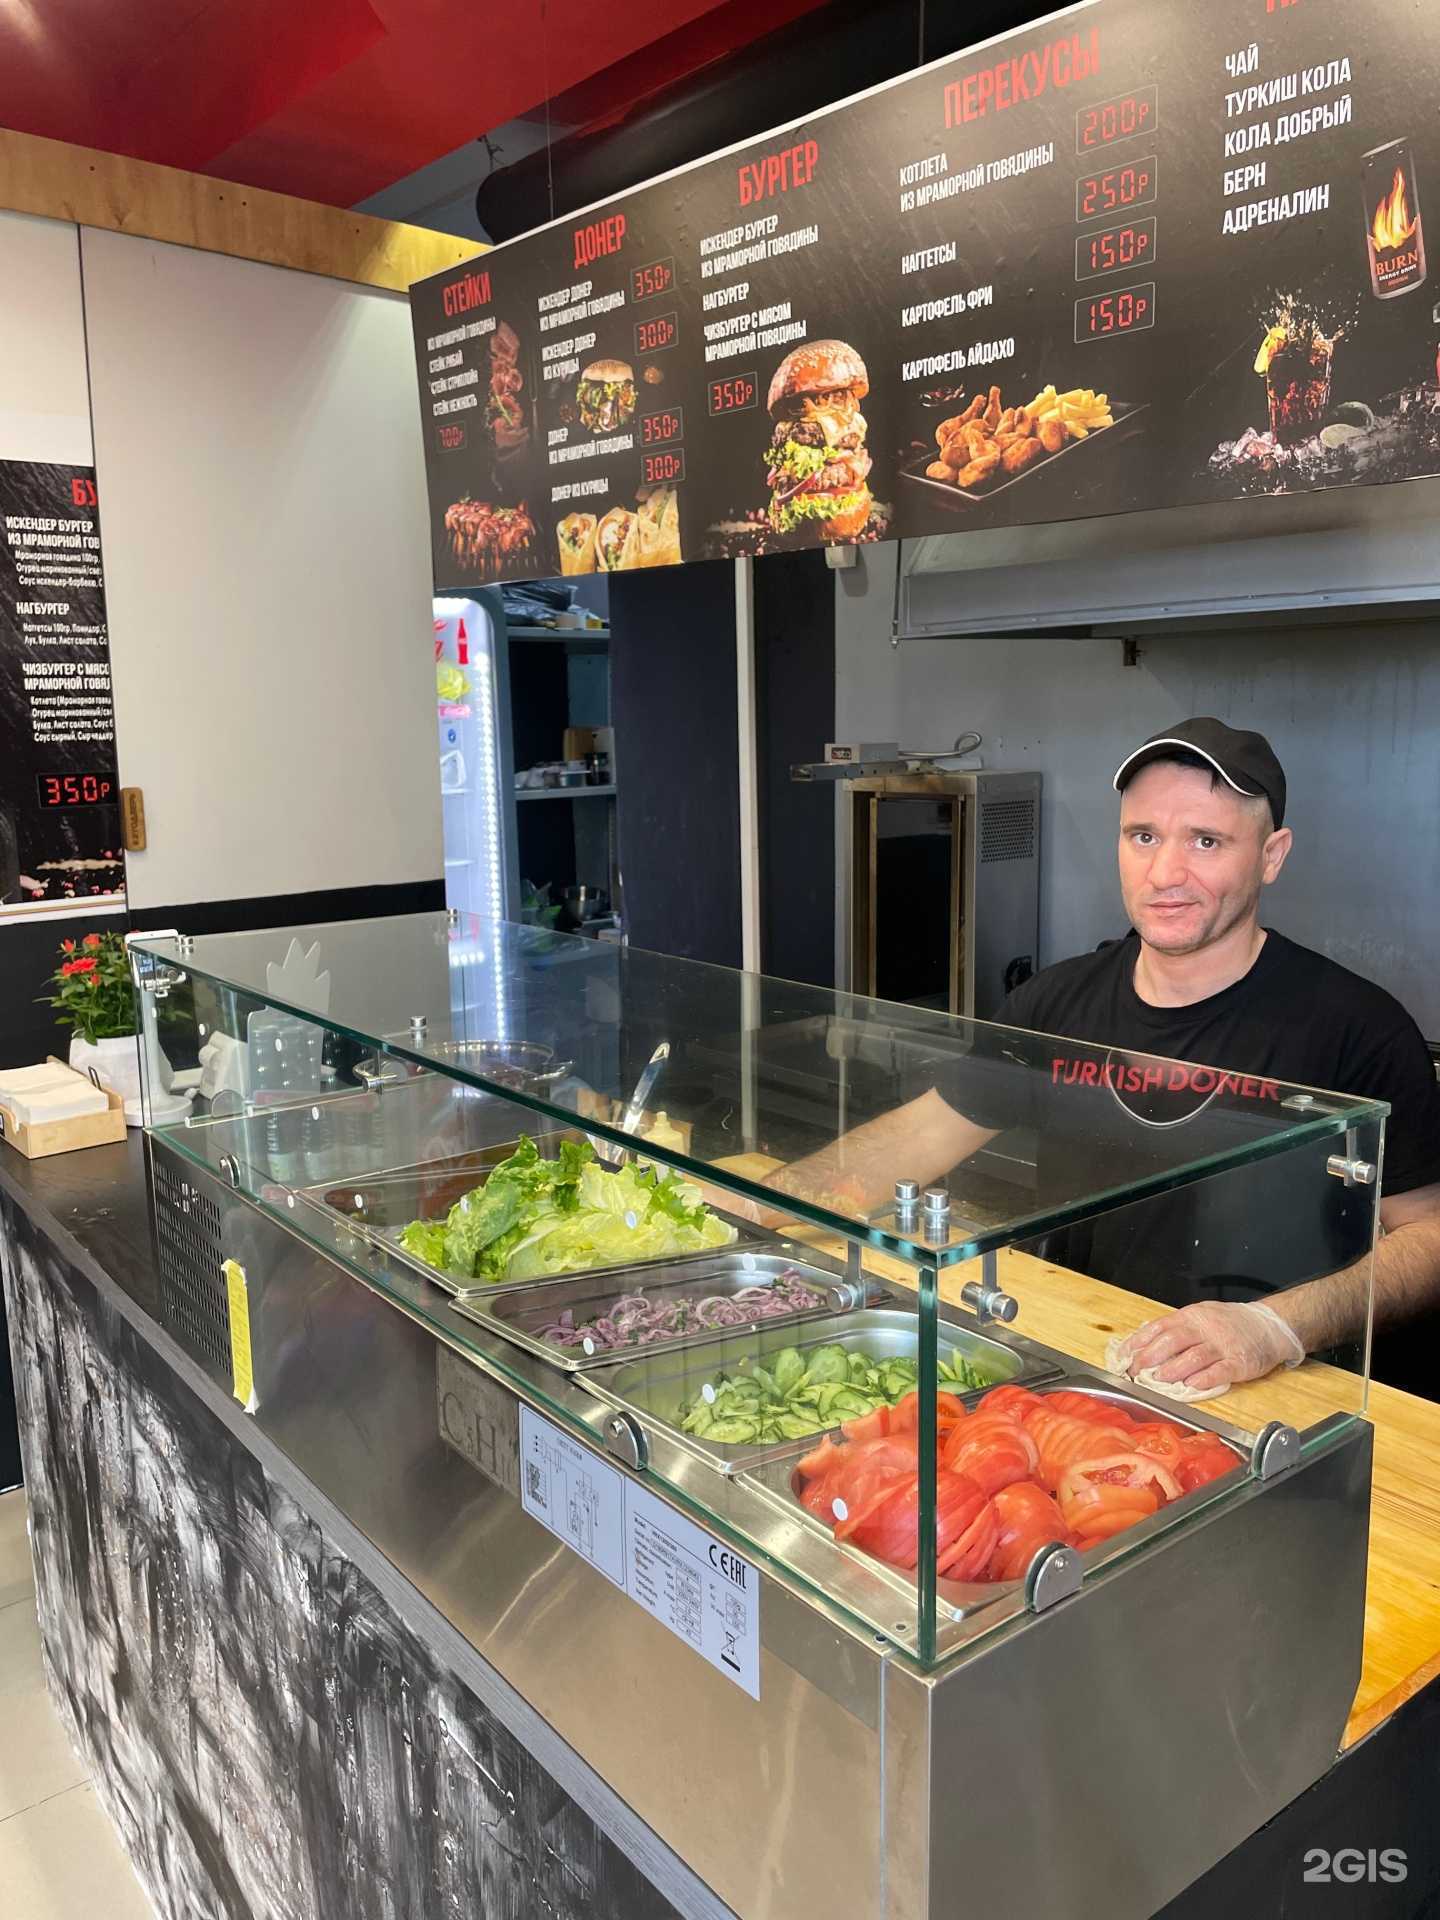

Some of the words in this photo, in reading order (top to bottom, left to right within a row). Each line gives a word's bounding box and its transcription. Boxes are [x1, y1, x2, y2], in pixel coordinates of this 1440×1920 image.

[943, 26, 1100, 129] ПЕРЕКУСЫ
[1225, 43, 1259, 77] ЧАЙ
[1224, 73, 1297, 118] ТУРКИШ
[1301, 57, 1352, 95] КОЛА
[1224, 121, 1271, 158] КОЛА
[1274, 94, 1352, 146] ДОБРЫЙ
[738, 139, 818, 207] БУРГЕР
[900, 152, 948, 187] КОТЛЕТА
[900, 193, 915, 213] ИЗ
[916, 165, 985, 208] МРАМОРНОЙ
[986, 142, 1054, 184] ГОВЯДИНЫ
[1223, 162, 1266, 196] БЕРН
[1222, 183, 1330, 235] АДРЕНАЛИН
[573, 214, 626, 269] ДОНЕР
[700, 226, 745, 256] ИСКЕНДЕР
[745, 214, 778, 241] БУРГЕР
[701, 260, 713, 279] ИЗ
[713, 240, 766, 275] МРАМОРНОЙ
[767, 224, 819, 257] ГОВЯДИНЫ
[901, 241, 957, 275] НАГГЕТСЫ
[1376, 250, 1418, 275] BURN
[443, 272, 493, 317] СТЕЙКИ
[703, 282, 749, 311] НАГБУРГЕР
[901, 295, 966, 328] КАРТОФЕЛЬ
[967, 285, 993, 311] ФРИ
[704, 314, 751, 341] ЧИЗБУРГЕР
[751, 312, 758, 329] С
[759, 302, 792, 327] МЯСОМ
[705, 331, 756, 362] МРАМОРНОЙ
[757, 320, 807, 348] ГОВЯДИНЫ
[902, 348, 966, 382] КАРТОФЕЛЬ
[967, 337, 1015, 368] АЙДАХО
[6, 516, 57, 531] ИСКЕНДЕР
[58, 519, 94, 533] БУРГЕР
[8, 532, 21, 545] ИЗ
[22, 533, 82, 548] МРАМОРНОЙ
[16, 602, 70, 615] НАГБУРГЕР
[22, 663, 76, 676] ЧИЗБУРГЕР
[77, 663, 84, 675] С
[24, 676, 83, 690] МРАМОРНОЙ
